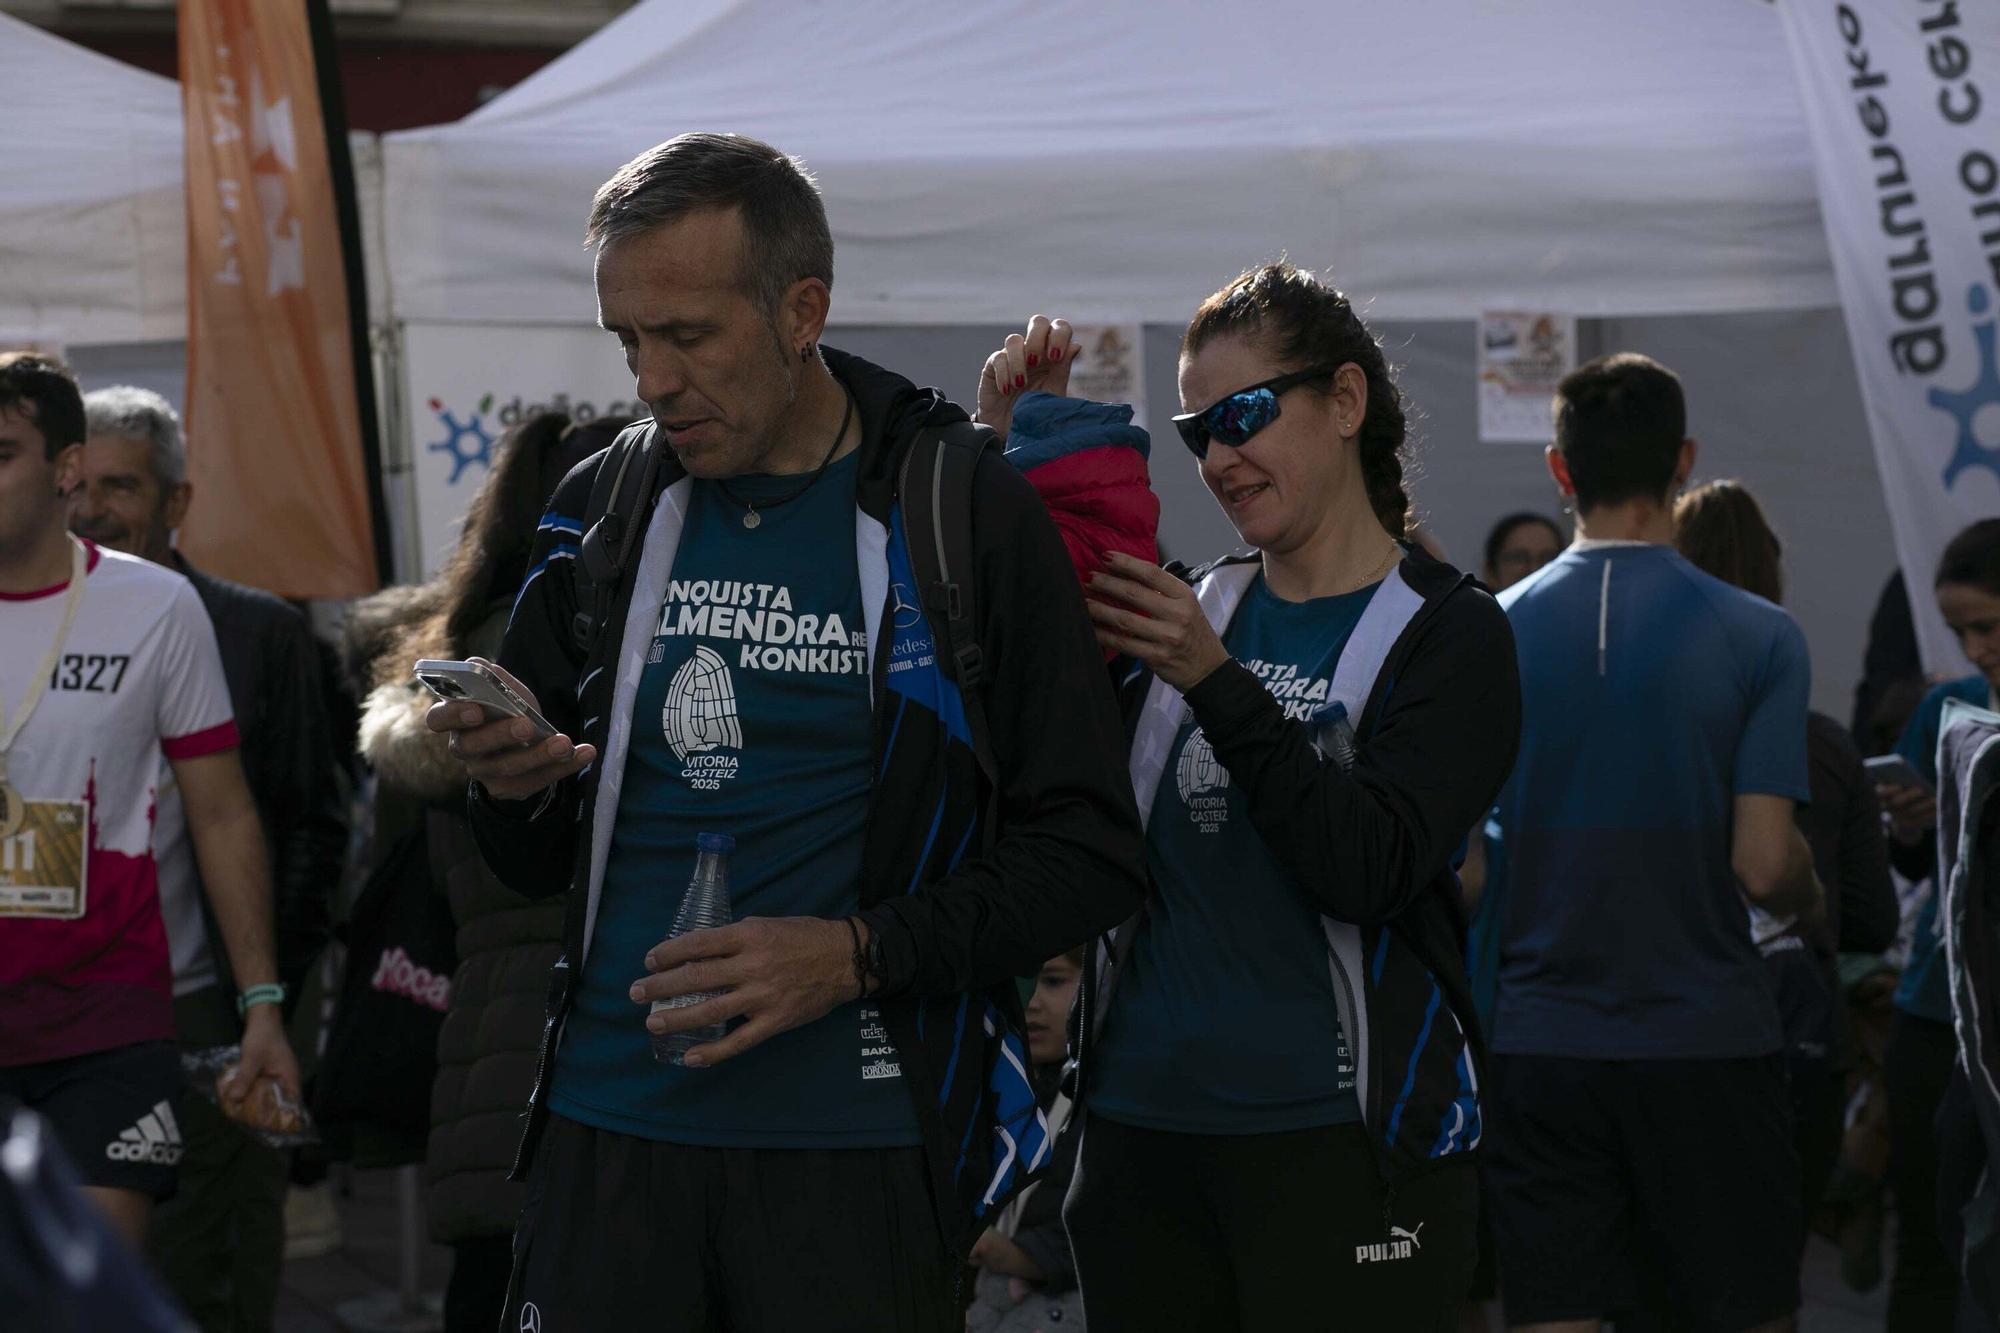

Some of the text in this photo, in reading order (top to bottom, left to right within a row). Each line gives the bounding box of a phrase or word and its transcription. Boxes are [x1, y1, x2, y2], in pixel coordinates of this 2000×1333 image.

[663, 580, 793, 612] NQUISTA
[739, 644, 870, 675] KONKIST
[686, 756, 739, 768] VITORIA
[681, 769, 738, 779] GASTEIZ
[691, 779, 720, 790] 2025
[1188, 798, 1227, 809] VITORIA
[1190, 810, 1227, 822] GASTEIZ
[1200, 823, 1220, 833] 2025
[862, 1063, 902, 1079] FORONDA
[1355, 1240, 1412, 1264] PUMA
